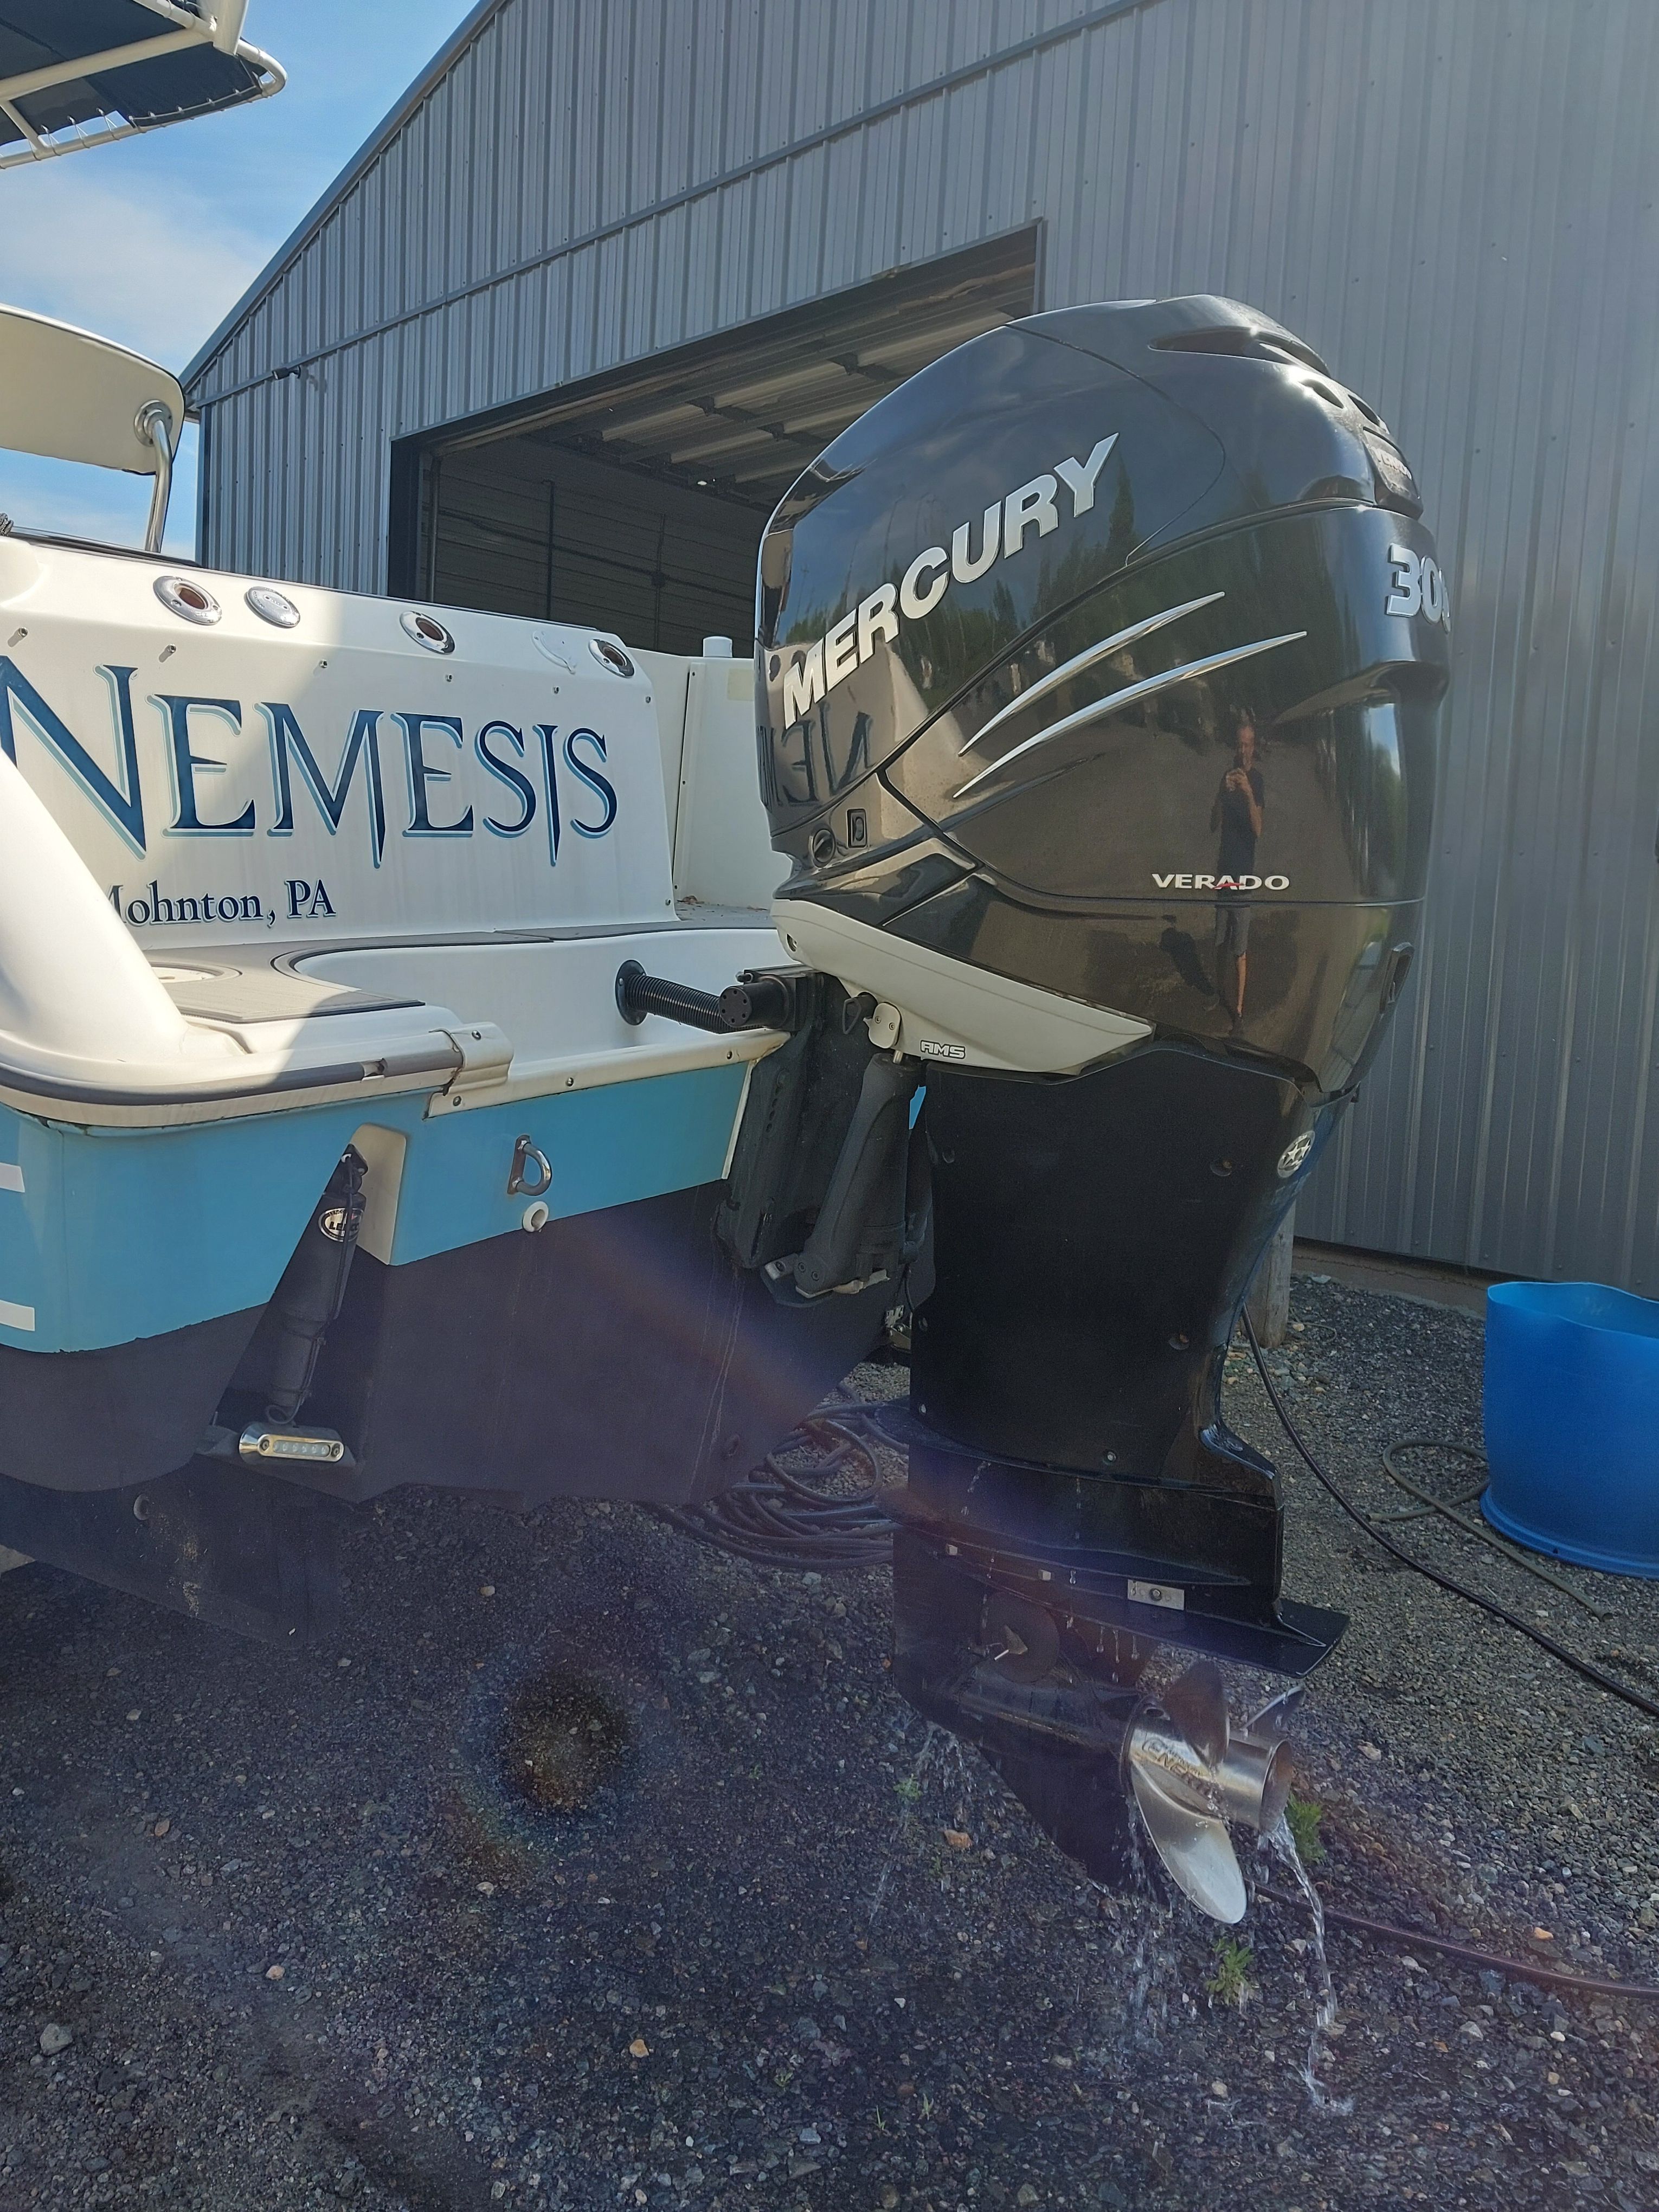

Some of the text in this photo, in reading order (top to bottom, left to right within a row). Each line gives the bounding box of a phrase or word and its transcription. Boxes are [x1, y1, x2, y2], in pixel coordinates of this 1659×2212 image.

[784, 432, 1119, 730] MERCURY
[0, 654, 618, 867] NEMESIS
[284, 878, 337, 919] PA
[1152, 873, 1290, 890] VERADO
[921, 1040, 966, 1059] AMS
